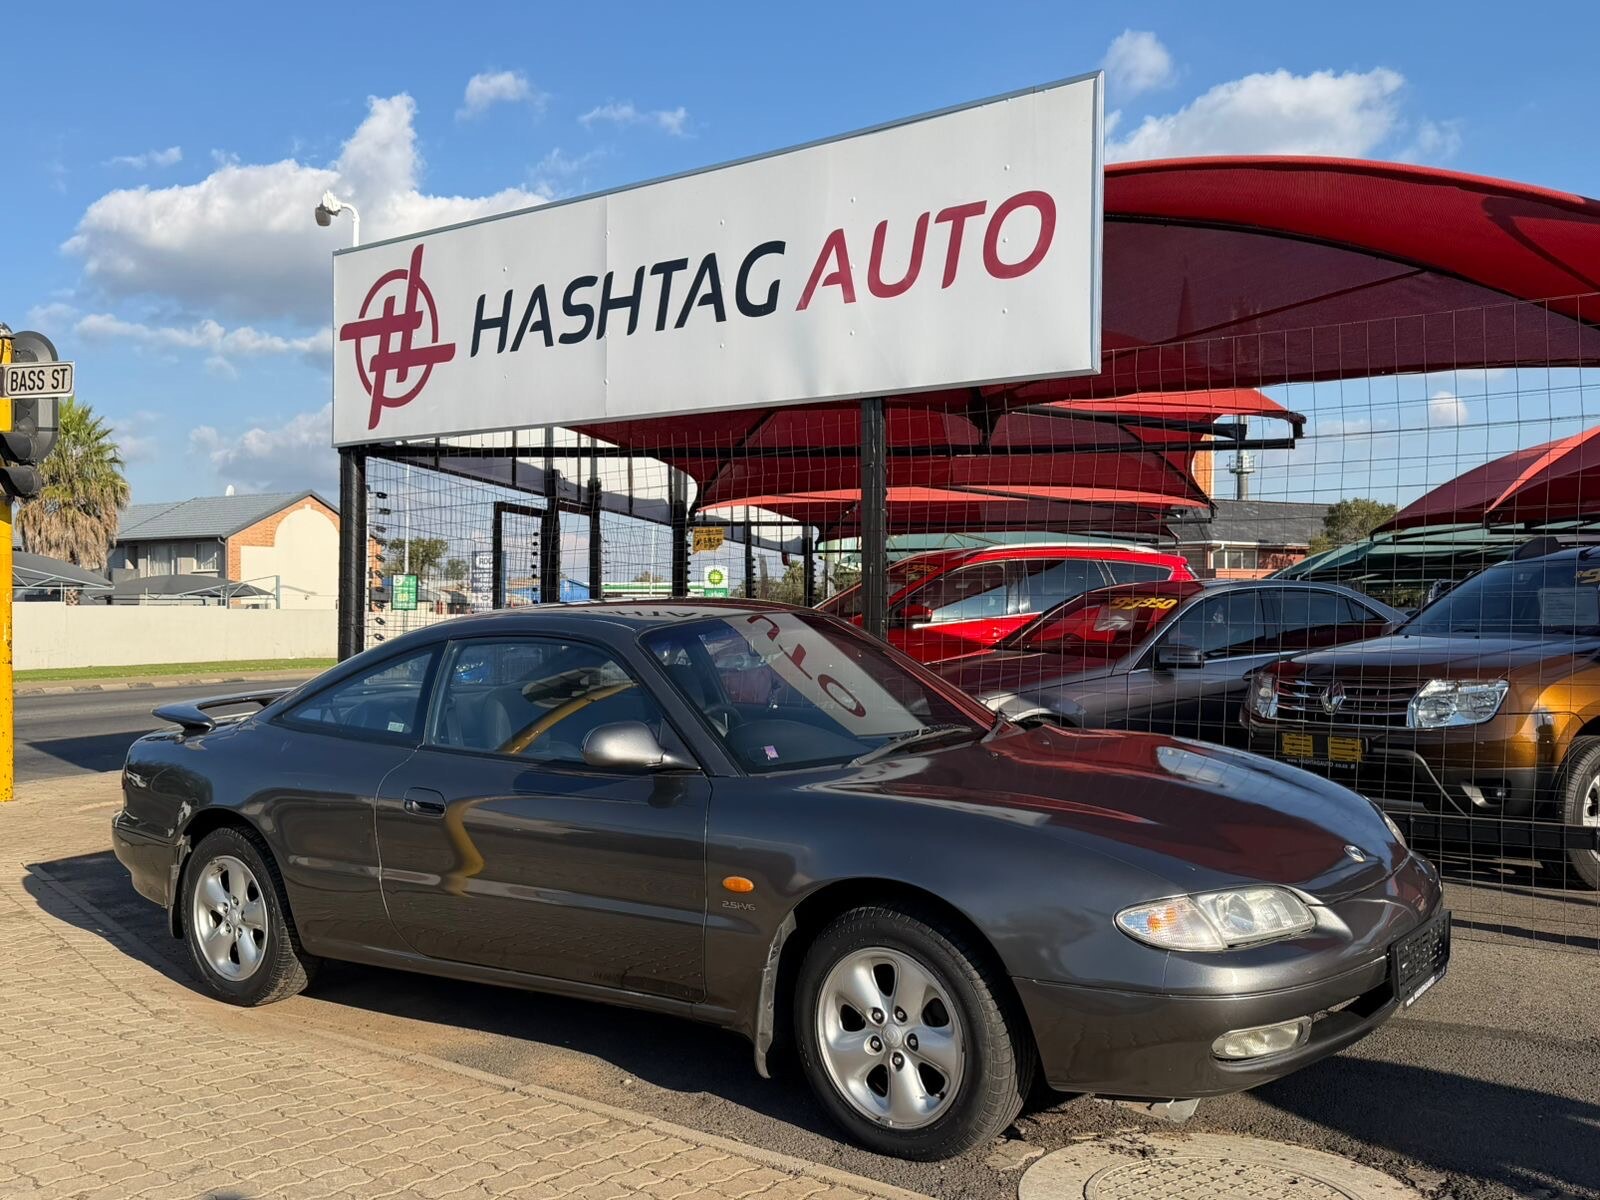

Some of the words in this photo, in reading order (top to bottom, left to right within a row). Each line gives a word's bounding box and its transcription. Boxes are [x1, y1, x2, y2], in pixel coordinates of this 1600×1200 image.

[470, 240, 786, 358] HASHTAG
[795, 190, 1057, 311] AUTO
[10, 370, 45, 392] BASS
[51, 368, 68, 390] ST
